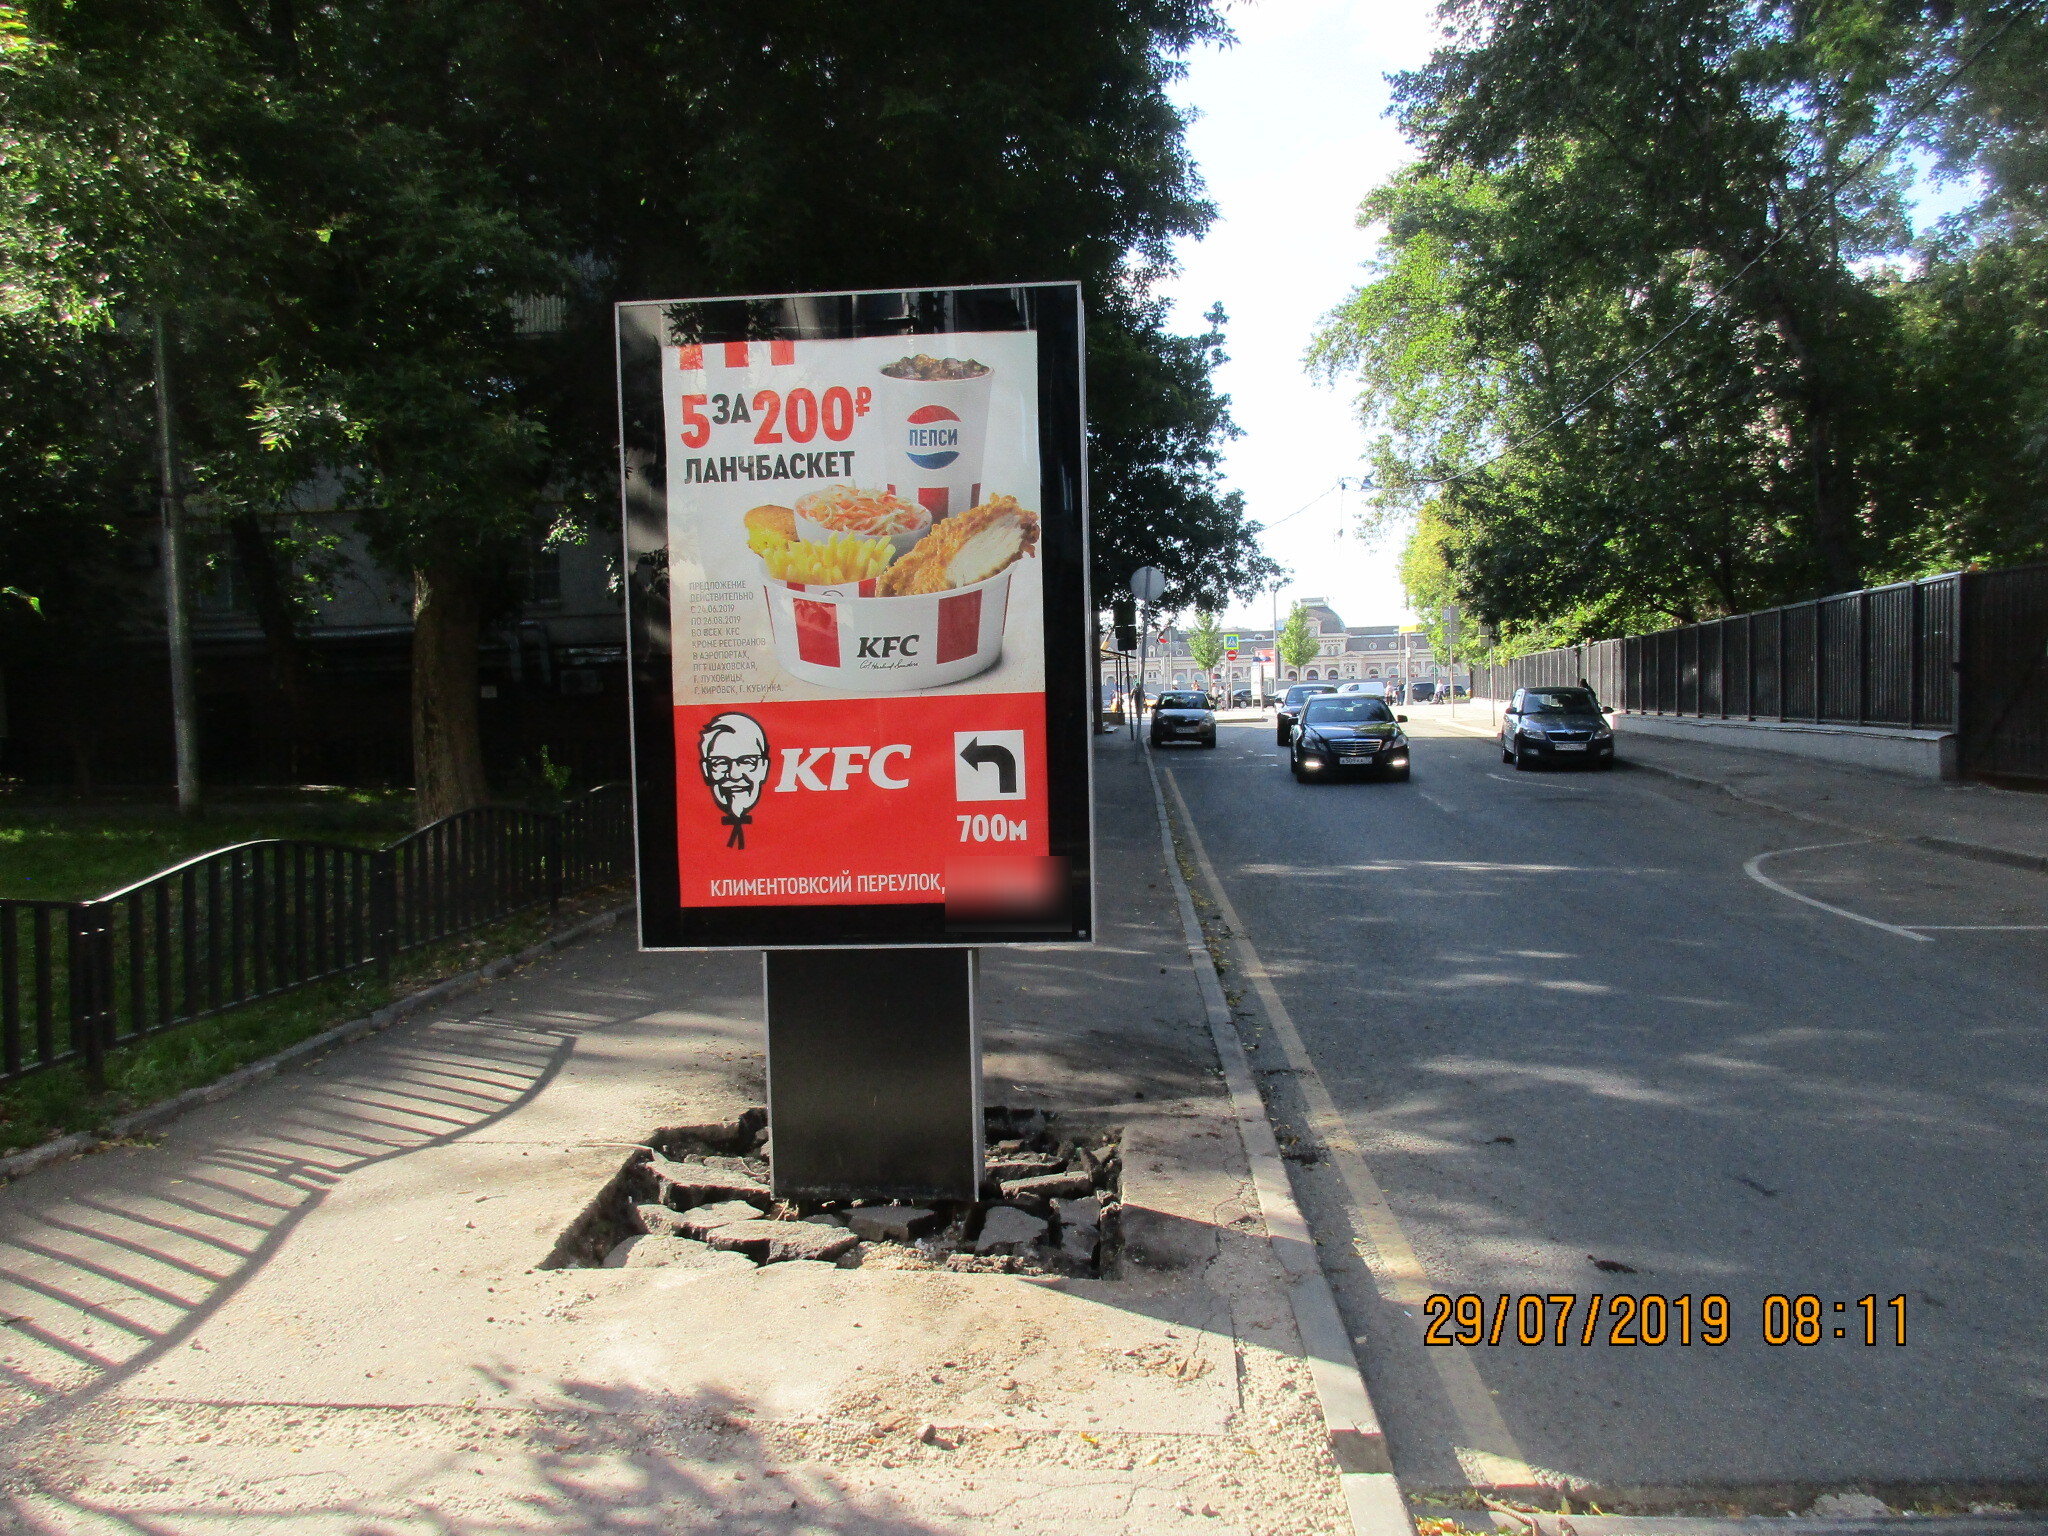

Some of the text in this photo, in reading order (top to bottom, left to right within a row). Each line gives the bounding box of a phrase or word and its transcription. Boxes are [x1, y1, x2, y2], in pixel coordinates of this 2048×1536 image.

[681, 394, 711, 449] 5
[711, 393, 751, 424] ЗА
[909, 428, 958, 447] ПЕПСИ
[684, 451, 855, 484] ЛАНЧБАСКЕТ
[689, 580, 747, 592] ПРЕДЛОЖЕНИЕ
[691, 617, 702, 626] ПО
[691, 627, 740, 637] ВО ВСЕХ KFC
[692, 637, 766, 648] КРОМЕ РЕСТОРАНОВ
[857, 634, 920, 658] KFC
[692, 650, 750, 660] В АЭРОПОРТАХ,
[708, 661, 758, 672] ШАХОВСКАЯ,
[775, 743, 912, 793] KFC
[710, 869, 946, 897] КЛИМЕНТОВКСИЙ ПЕРЕУЛОК,
